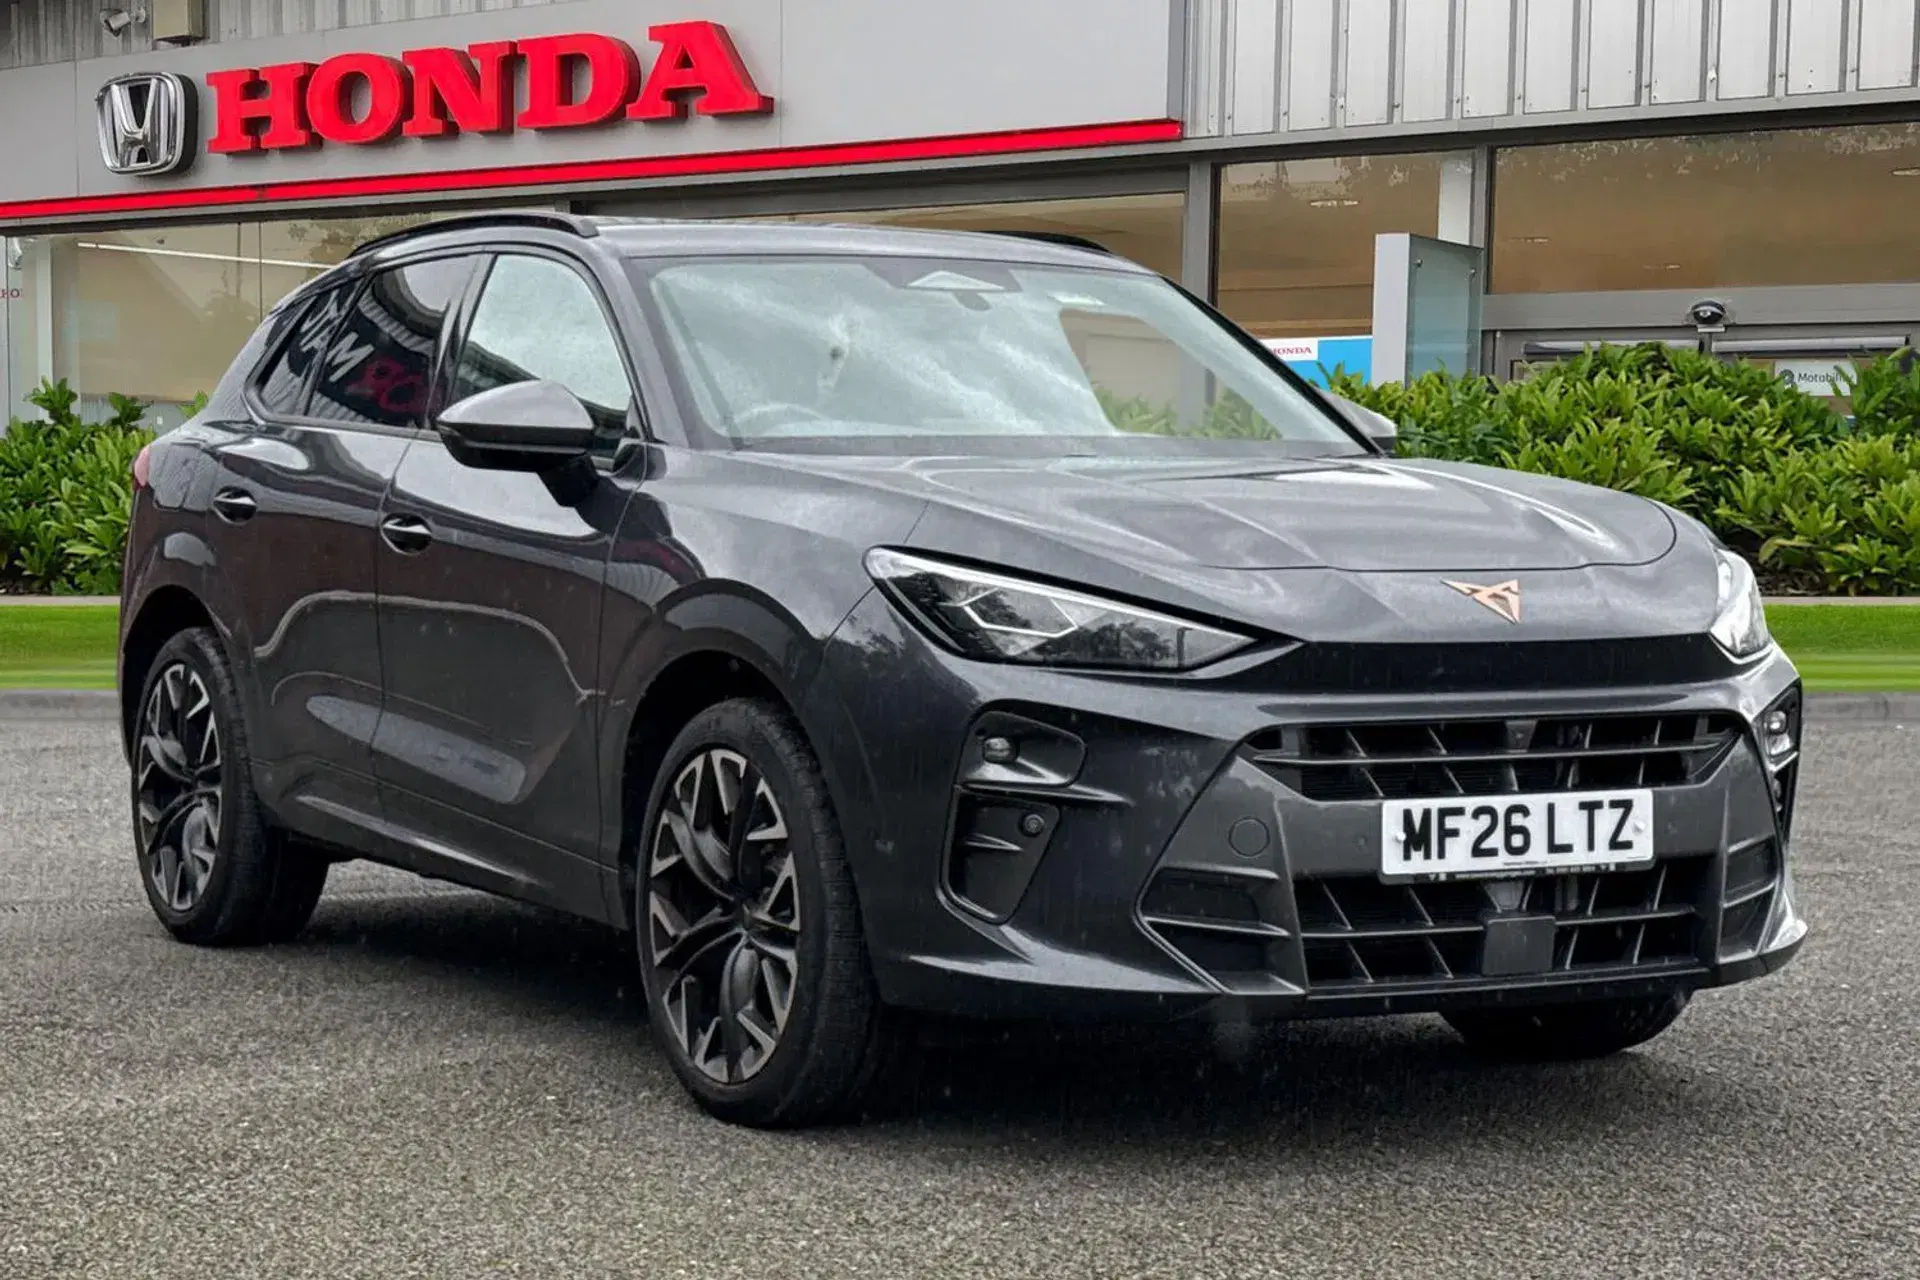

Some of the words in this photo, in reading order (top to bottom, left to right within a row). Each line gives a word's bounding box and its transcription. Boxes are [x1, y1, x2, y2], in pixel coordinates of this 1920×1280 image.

[207, 20, 774, 154] HONDA
[1402, 803, 1531, 861] MF26
[1547, 798, 1634, 854] LTZ
